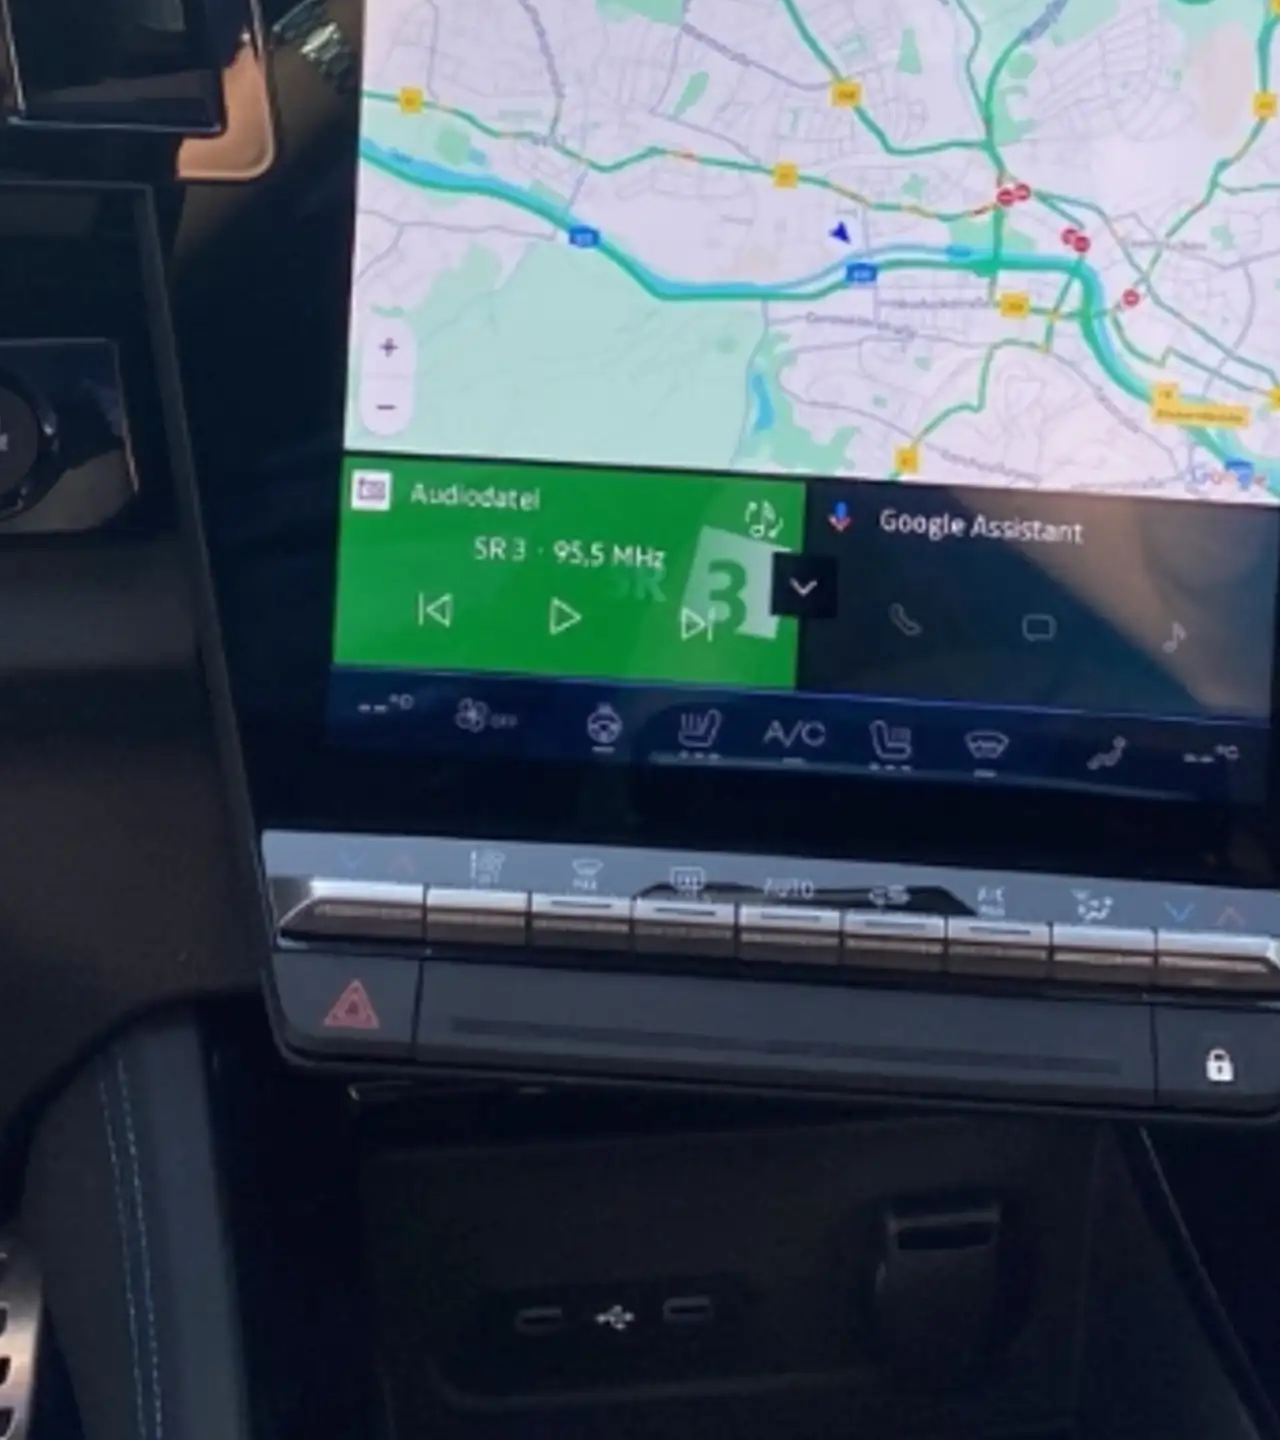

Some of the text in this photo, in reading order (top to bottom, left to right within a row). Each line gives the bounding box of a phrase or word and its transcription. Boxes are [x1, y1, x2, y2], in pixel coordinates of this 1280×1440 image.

[411, 483, 541, 511] Audiodatei
[880, 508, 1084, 545] Google Assistant
[474, 536, 667, 571] SR 3 95,5 MHz
[763, 720, 826, 749] A/C
